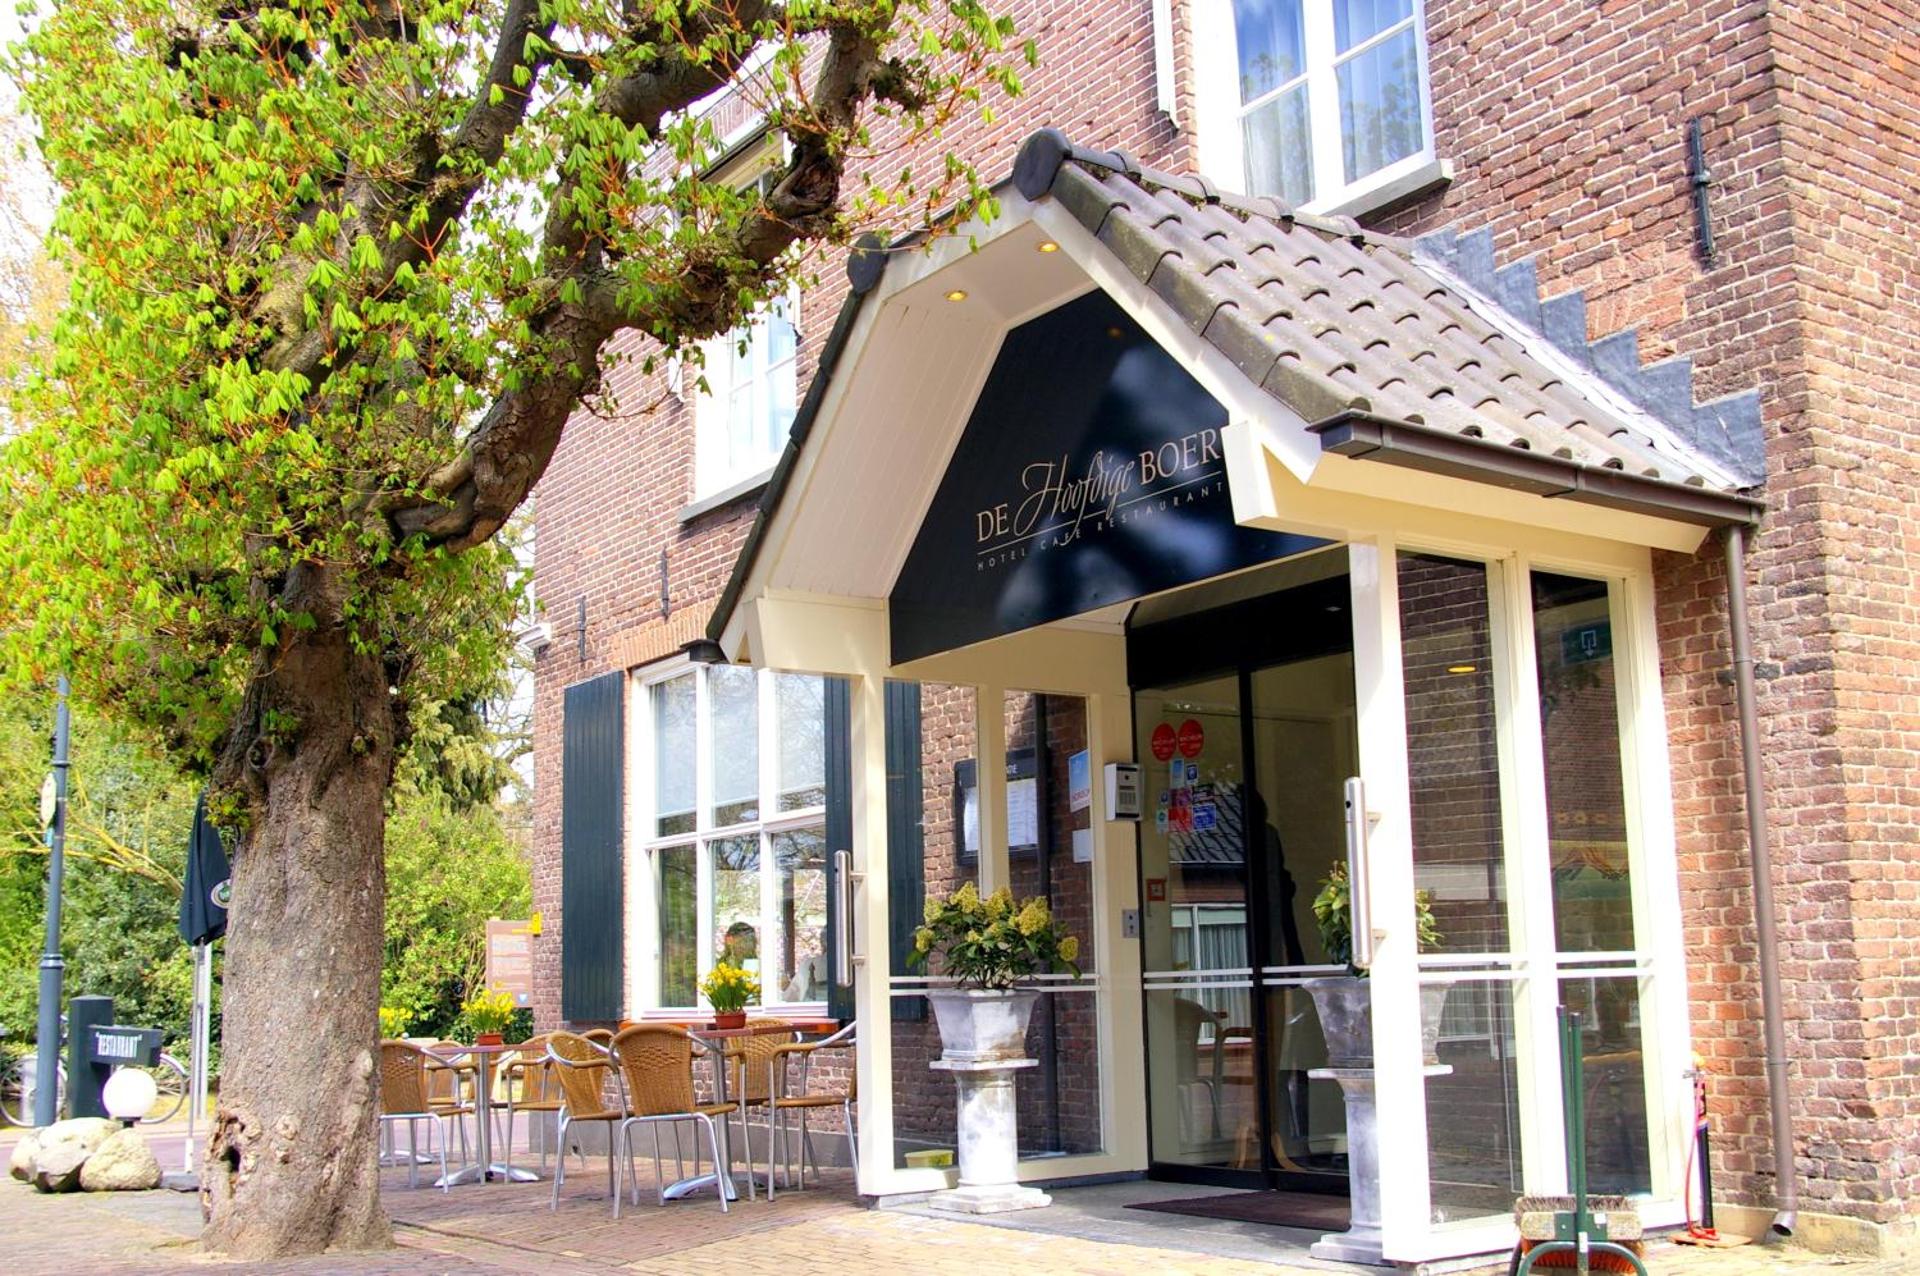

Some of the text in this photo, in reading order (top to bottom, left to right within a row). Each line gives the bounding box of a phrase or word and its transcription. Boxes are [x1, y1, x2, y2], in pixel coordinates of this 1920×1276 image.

[977, 428, 1221, 546] DE Hoofdige BOER
[977, 548, 1025, 571] HOTEL
[1097, 482, 1222, 531] RESTAURANT
